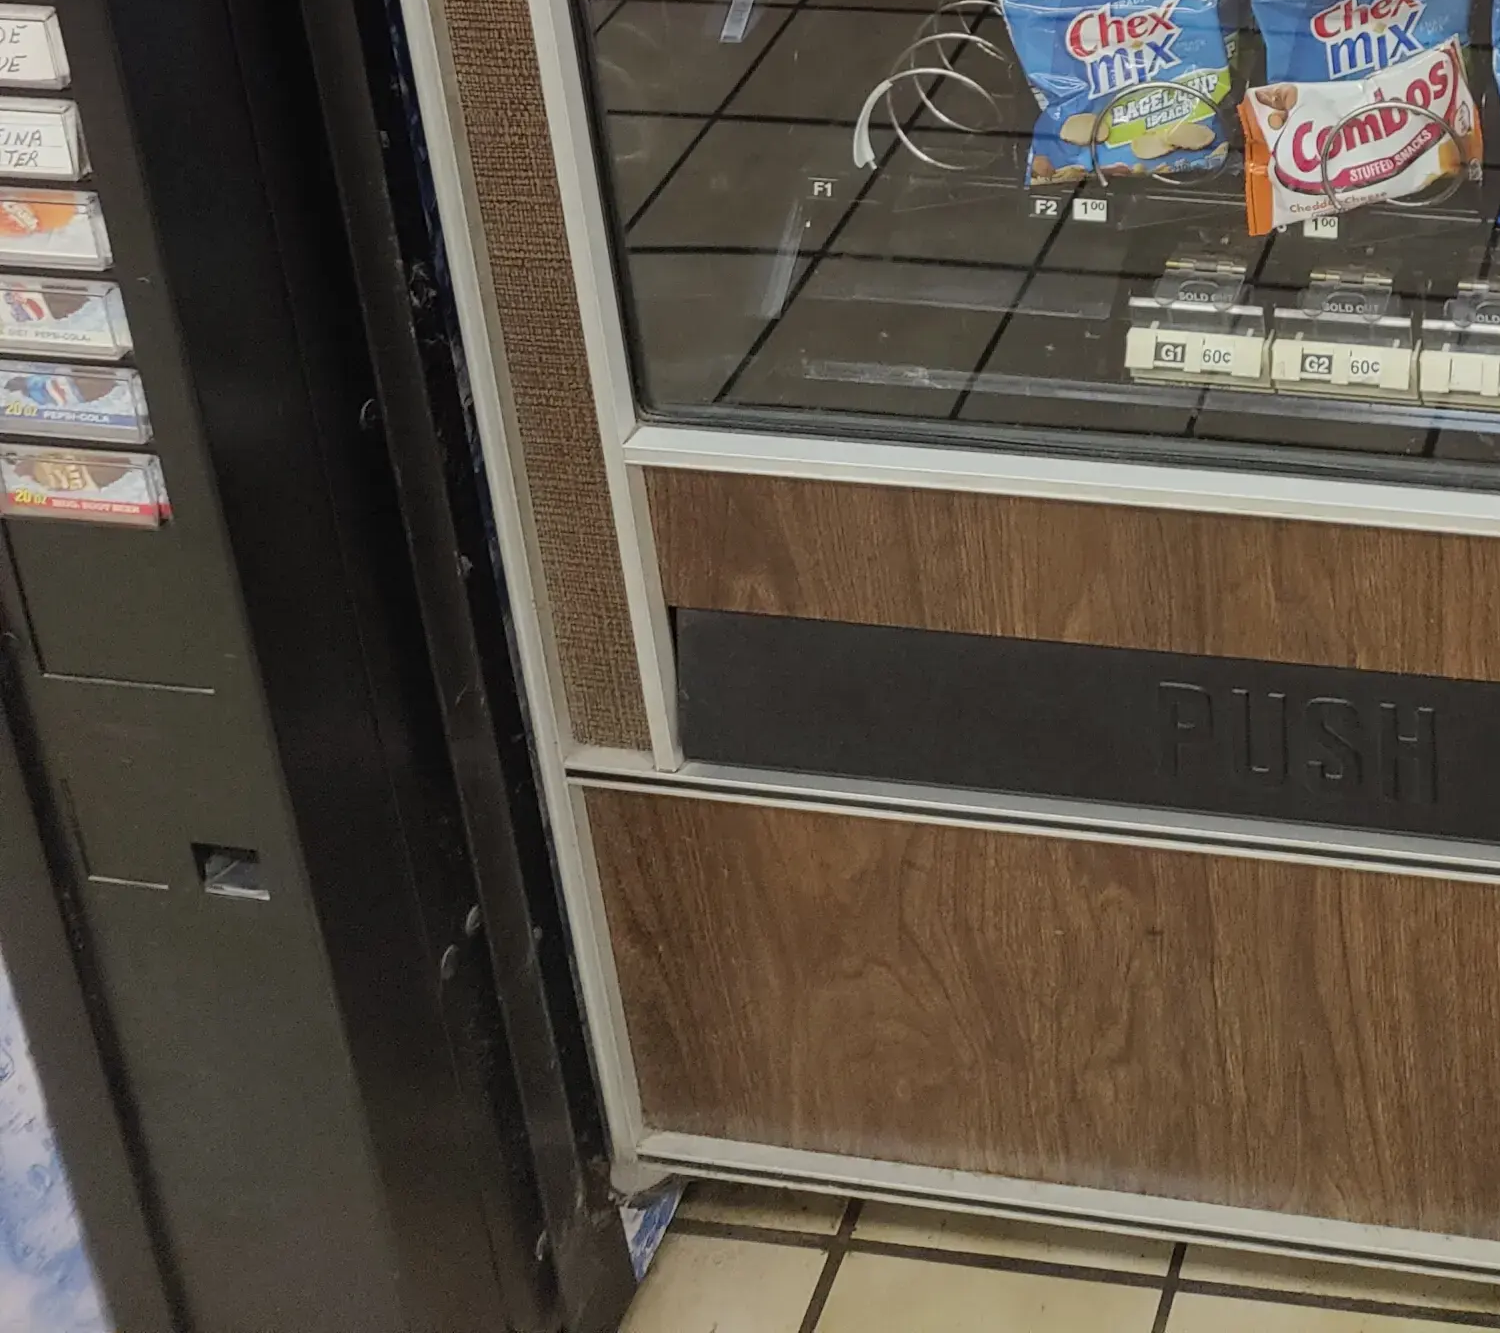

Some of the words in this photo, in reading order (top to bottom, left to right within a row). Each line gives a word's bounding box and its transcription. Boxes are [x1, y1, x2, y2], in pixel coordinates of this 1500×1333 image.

[1070, 3, 1175, 57] Chex
[1331, 12, 1422, 76] mix
[1090, 34, 1175, 96] mix
[1292, 60, 1448, 173] Combos
[1349, 158, 1395, 182] STUFFED
[1396, 128, 1433, 166] SNACKS
[813, 181, 833, 198] F1
[1035, 199, 1058, 216] F2
[1161, 345, 1183, 361] G1
[1305, 357, 1329, 374] G2
[1157, 681, 1438, 805] PUSH
